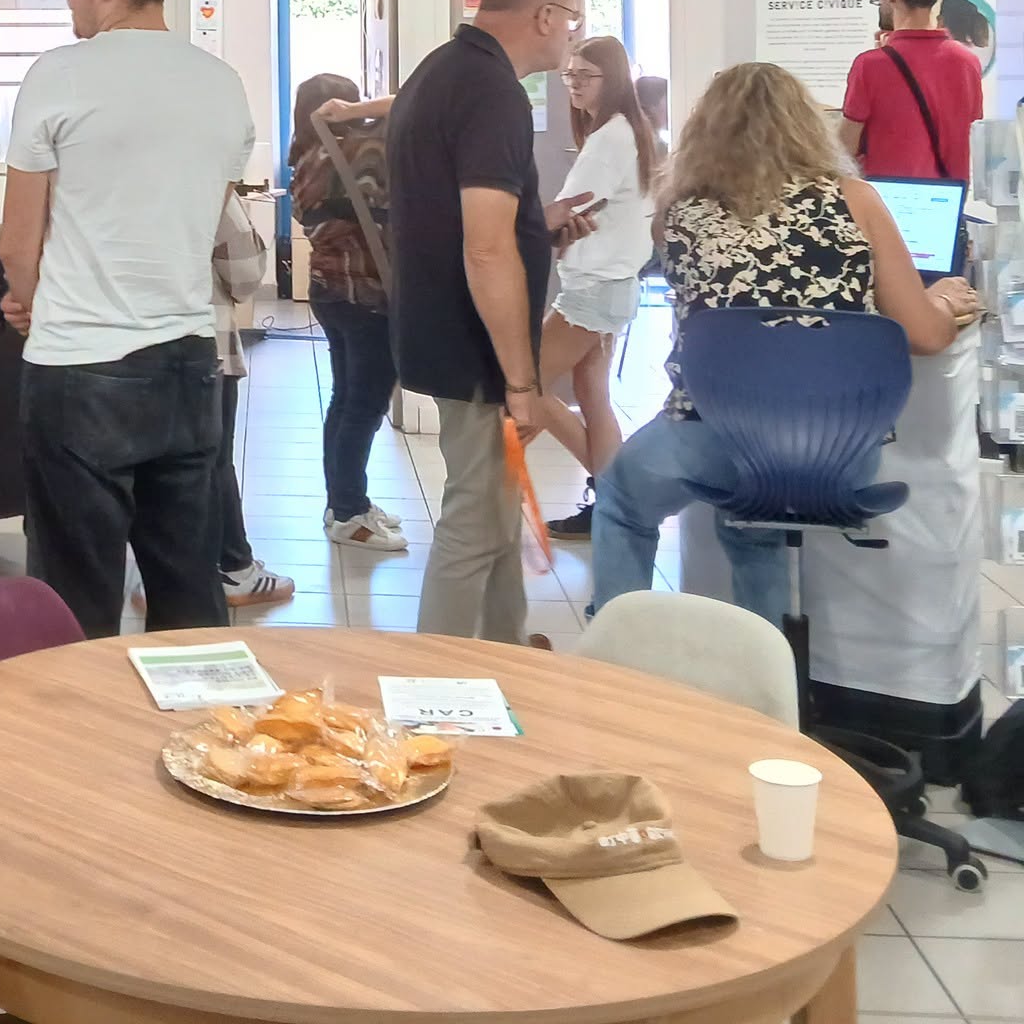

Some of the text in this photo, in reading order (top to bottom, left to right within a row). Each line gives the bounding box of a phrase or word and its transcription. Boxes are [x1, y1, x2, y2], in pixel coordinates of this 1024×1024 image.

[768, 0, 863, 10] SERVICE CIVIQUE
[418, 708, 474, 717] CAR
